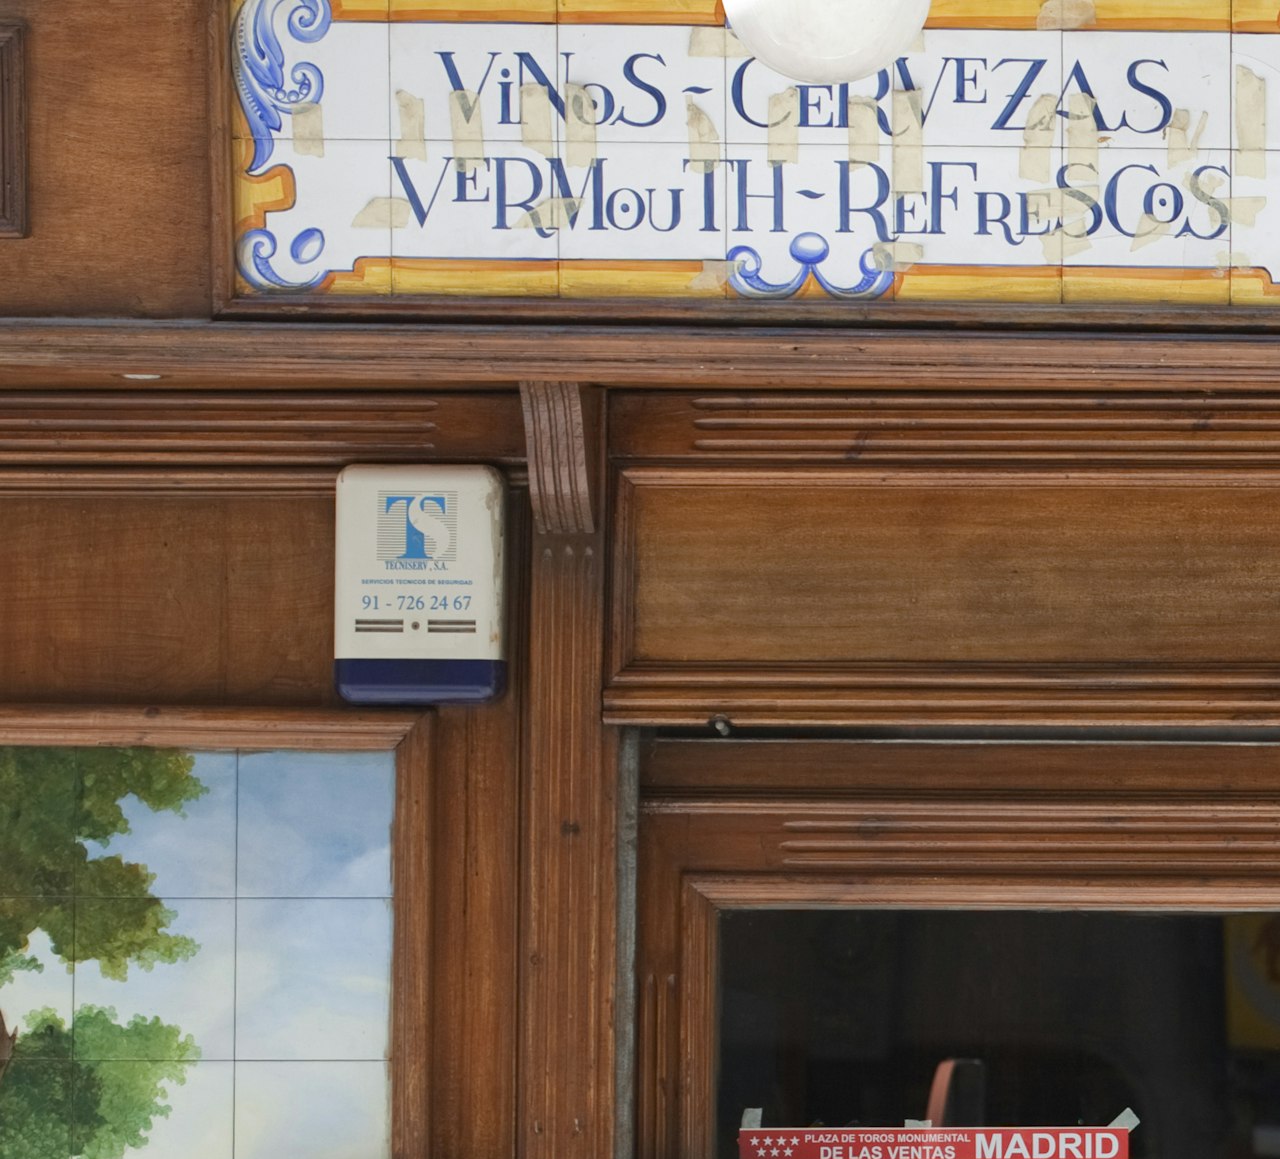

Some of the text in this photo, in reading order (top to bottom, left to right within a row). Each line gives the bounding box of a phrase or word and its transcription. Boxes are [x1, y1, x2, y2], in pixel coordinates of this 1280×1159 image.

[361, 595, 380, 611] 91
[397, 595, 426, 611] 726
[430, 595, 449, 611] 24
[453, 595, 472, 611] 67
[804, 1133, 971, 1144] PLAZA DE TOROS MONUMENTAL
[819, 1146, 845, 1159] DE
[848, 1146, 883, 1159] LAS
[975, 1133, 1120, 1159] MADRID
